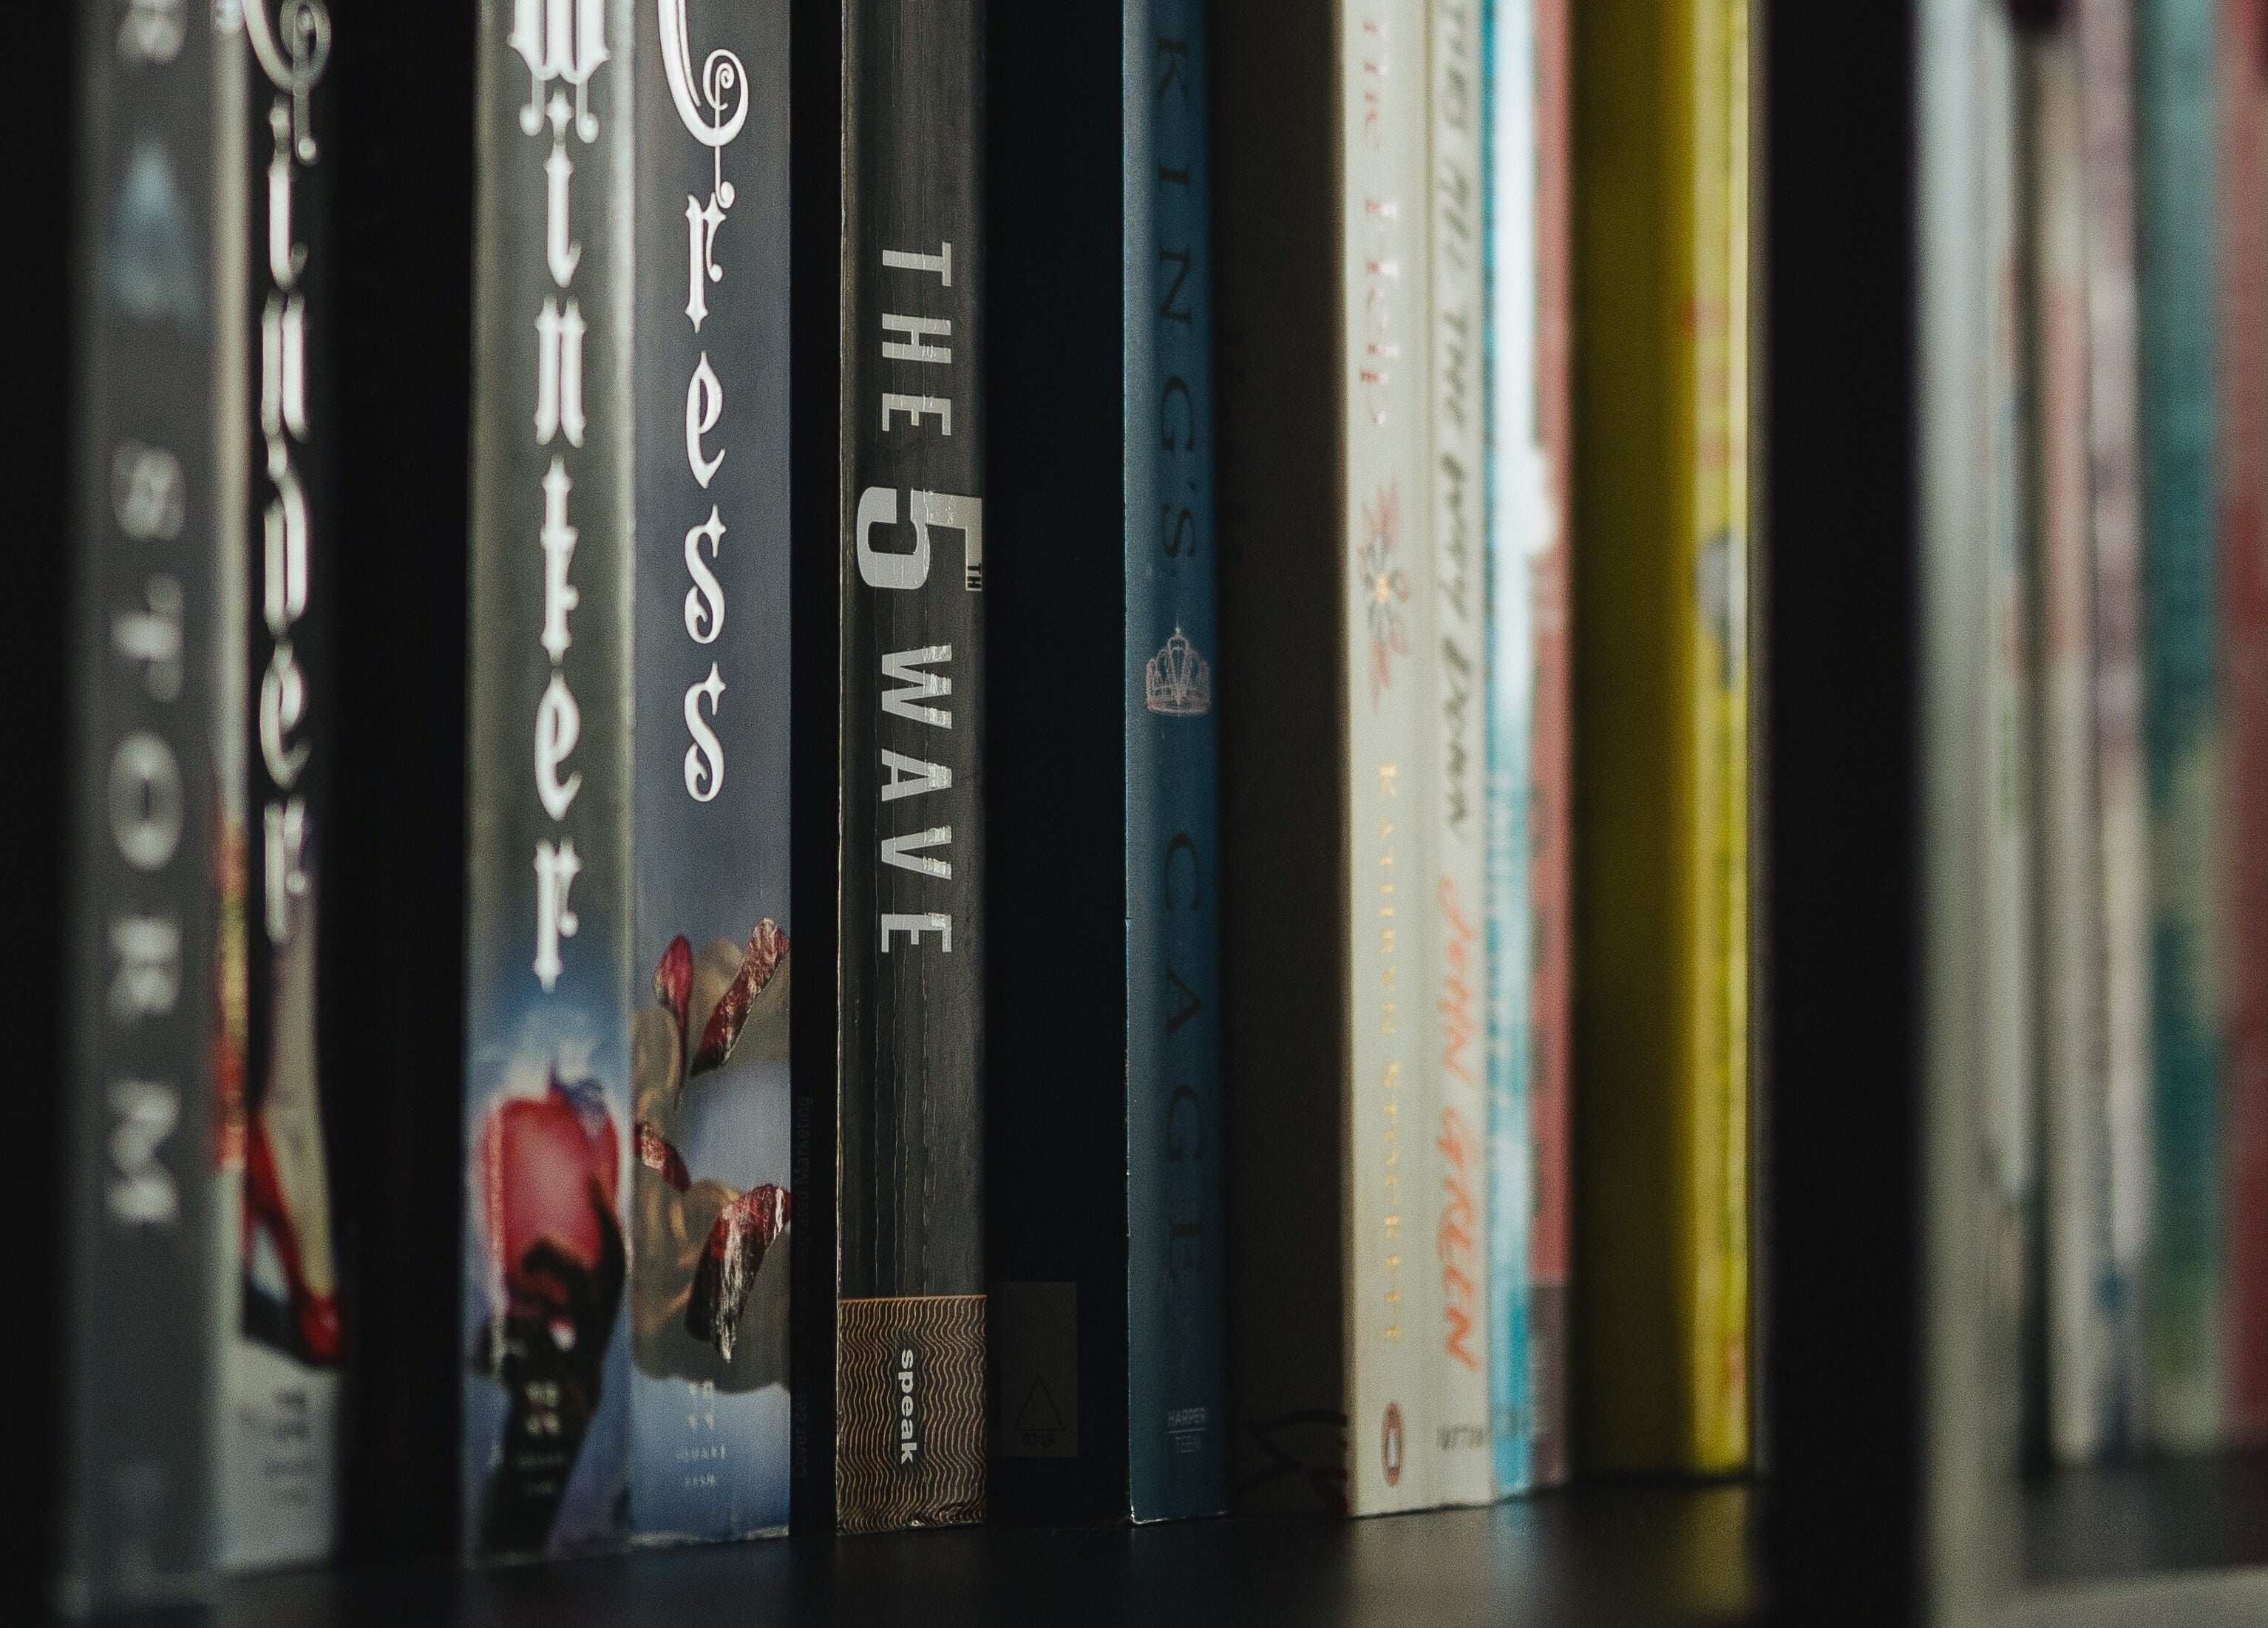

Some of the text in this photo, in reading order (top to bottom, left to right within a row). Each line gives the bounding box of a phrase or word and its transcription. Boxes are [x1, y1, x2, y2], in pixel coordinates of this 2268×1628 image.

[882, 242, 951, 436] THE
[856, 486, 982, 591] 5
[881, 643, 952, 954] WAVE
[1163, 832, 1203, 1280] CAGE
[793, 1096, 812, 1185] Marketing
[897, 1349, 917, 1465] speak
